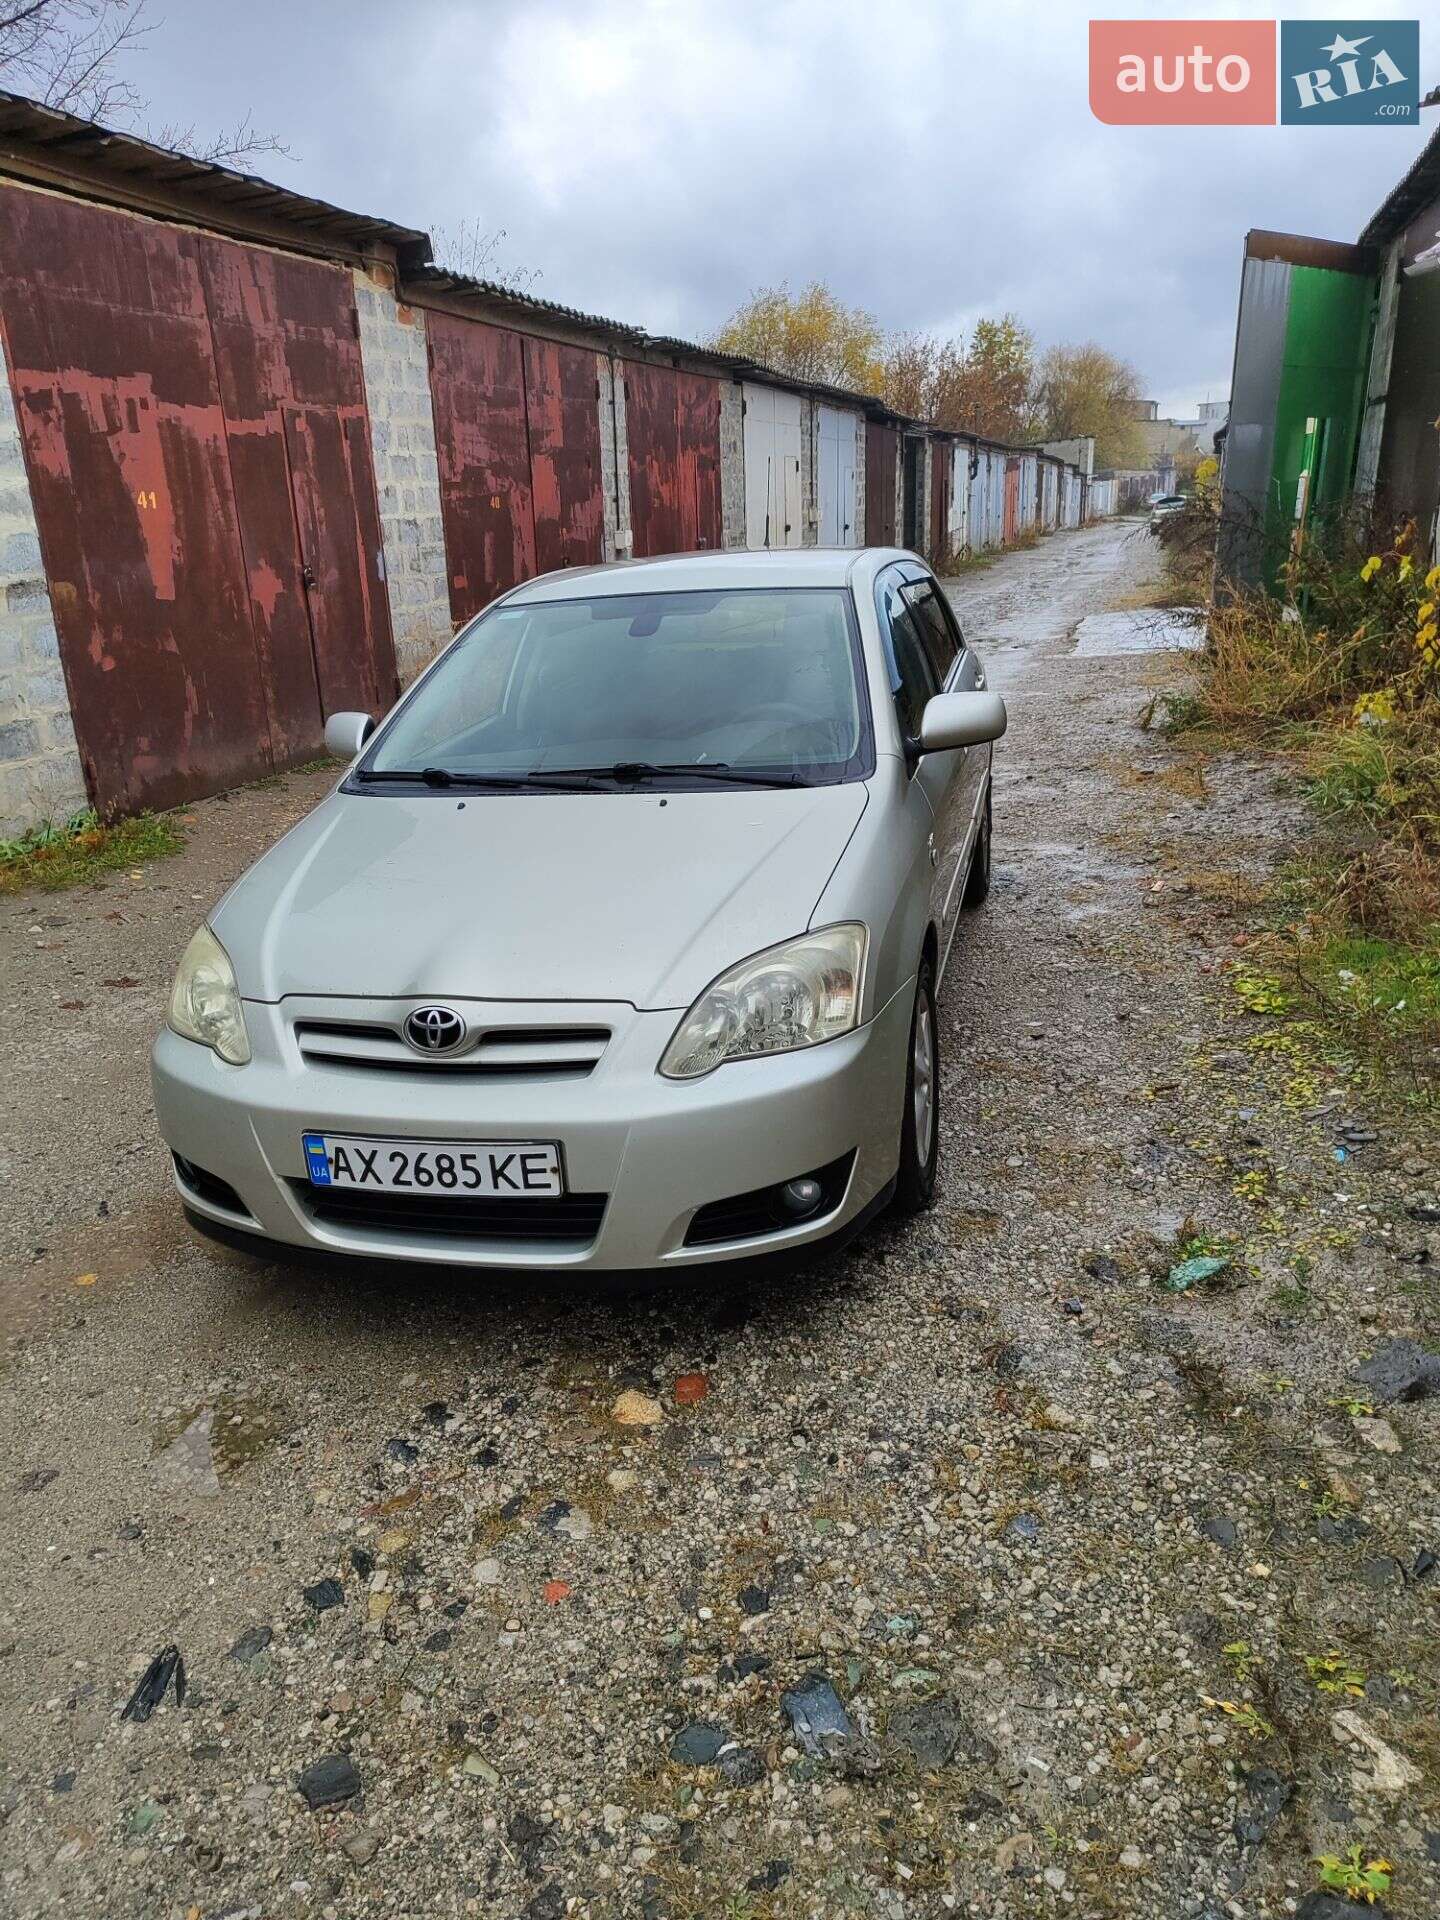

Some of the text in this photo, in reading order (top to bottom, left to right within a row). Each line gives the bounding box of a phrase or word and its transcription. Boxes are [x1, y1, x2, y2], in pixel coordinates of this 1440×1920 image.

[137, 490, 157, 509] 41
[312, 1167, 329, 1179] UA
[333, 1147, 552, 1190] AX 2685 KE
